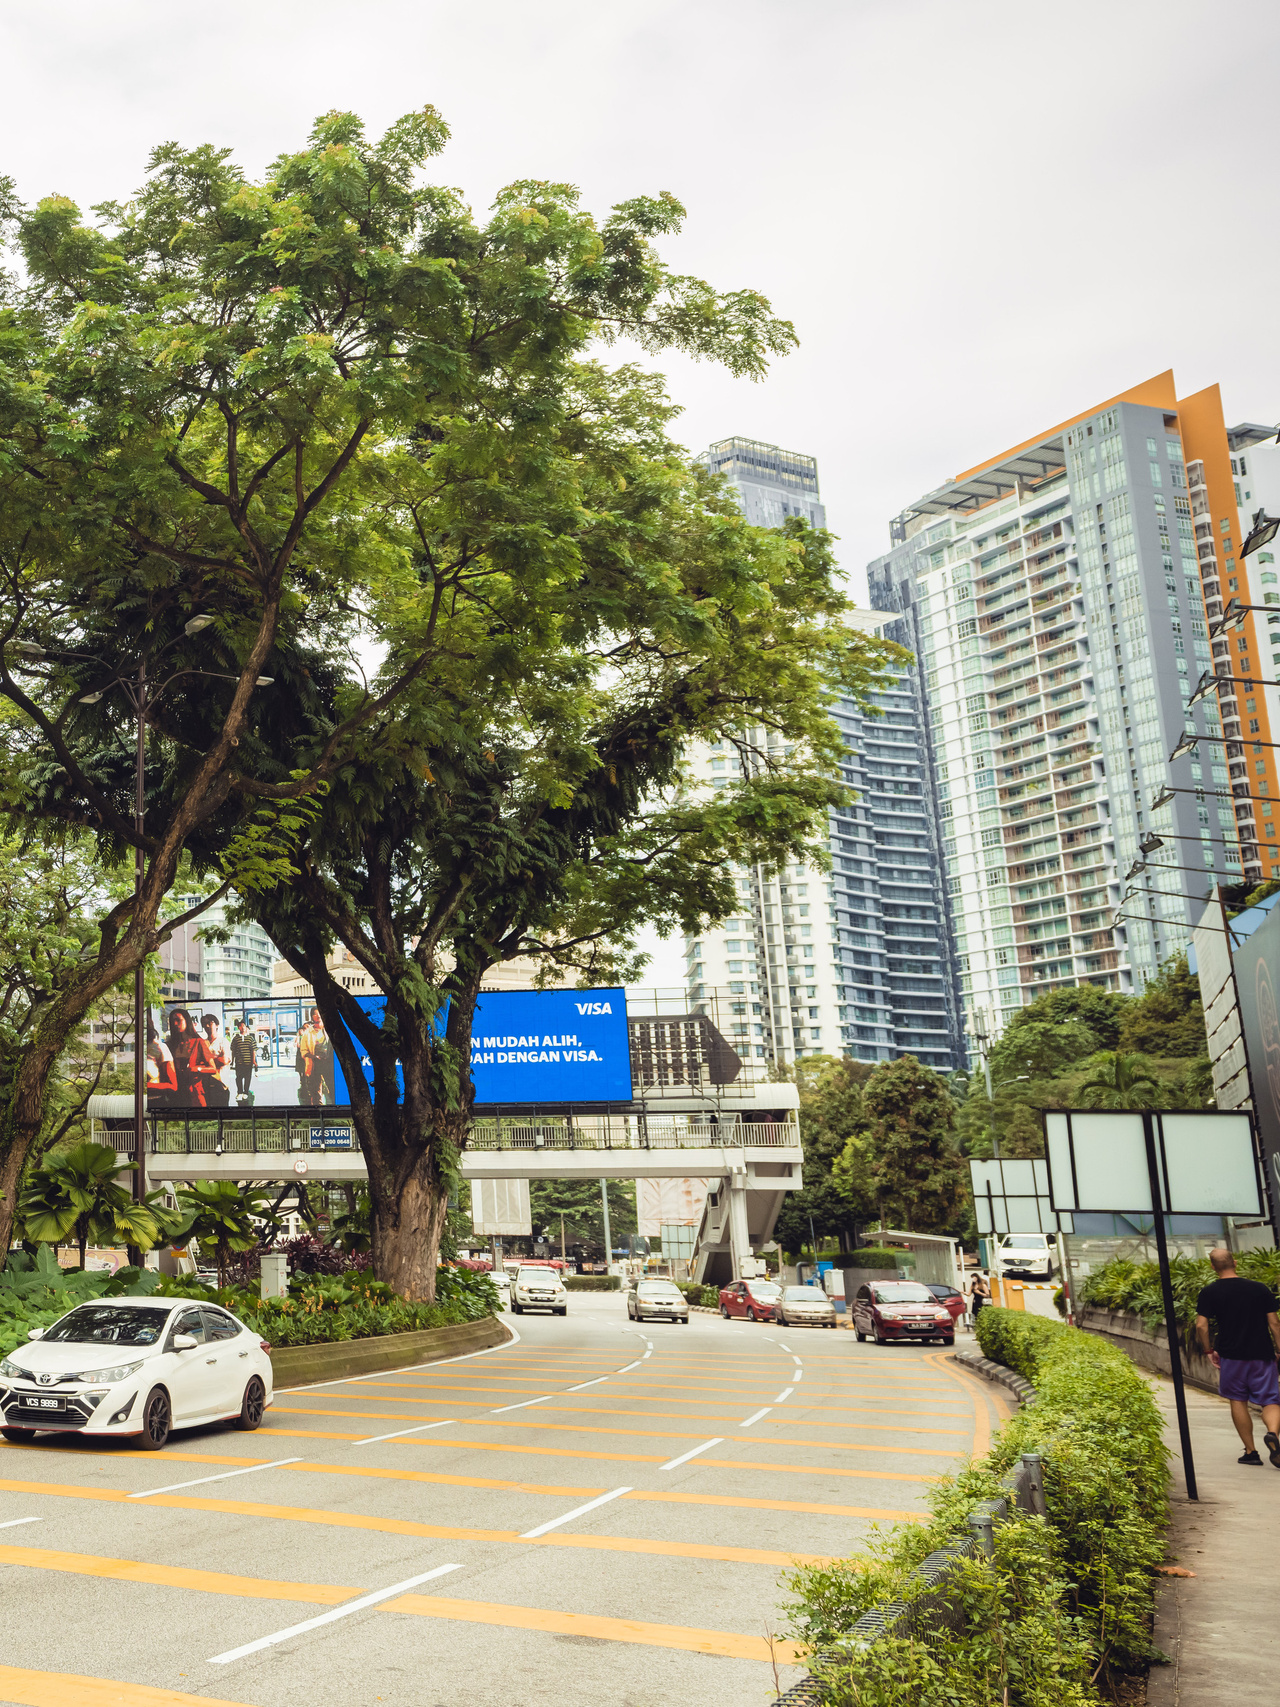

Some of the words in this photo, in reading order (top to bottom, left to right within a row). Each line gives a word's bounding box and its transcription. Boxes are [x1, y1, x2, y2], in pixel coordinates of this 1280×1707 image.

[574, 1002, 612, 1015] VISA
[483, 1036, 539, 1048] MUDAH
[542, 1035, 582, 1047] ALIH,
[497, 1051, 560, 1063] DENGAN
[562, 1050, 603, 1062] VISA.
[26, 1398, 39, 1406] VCS
